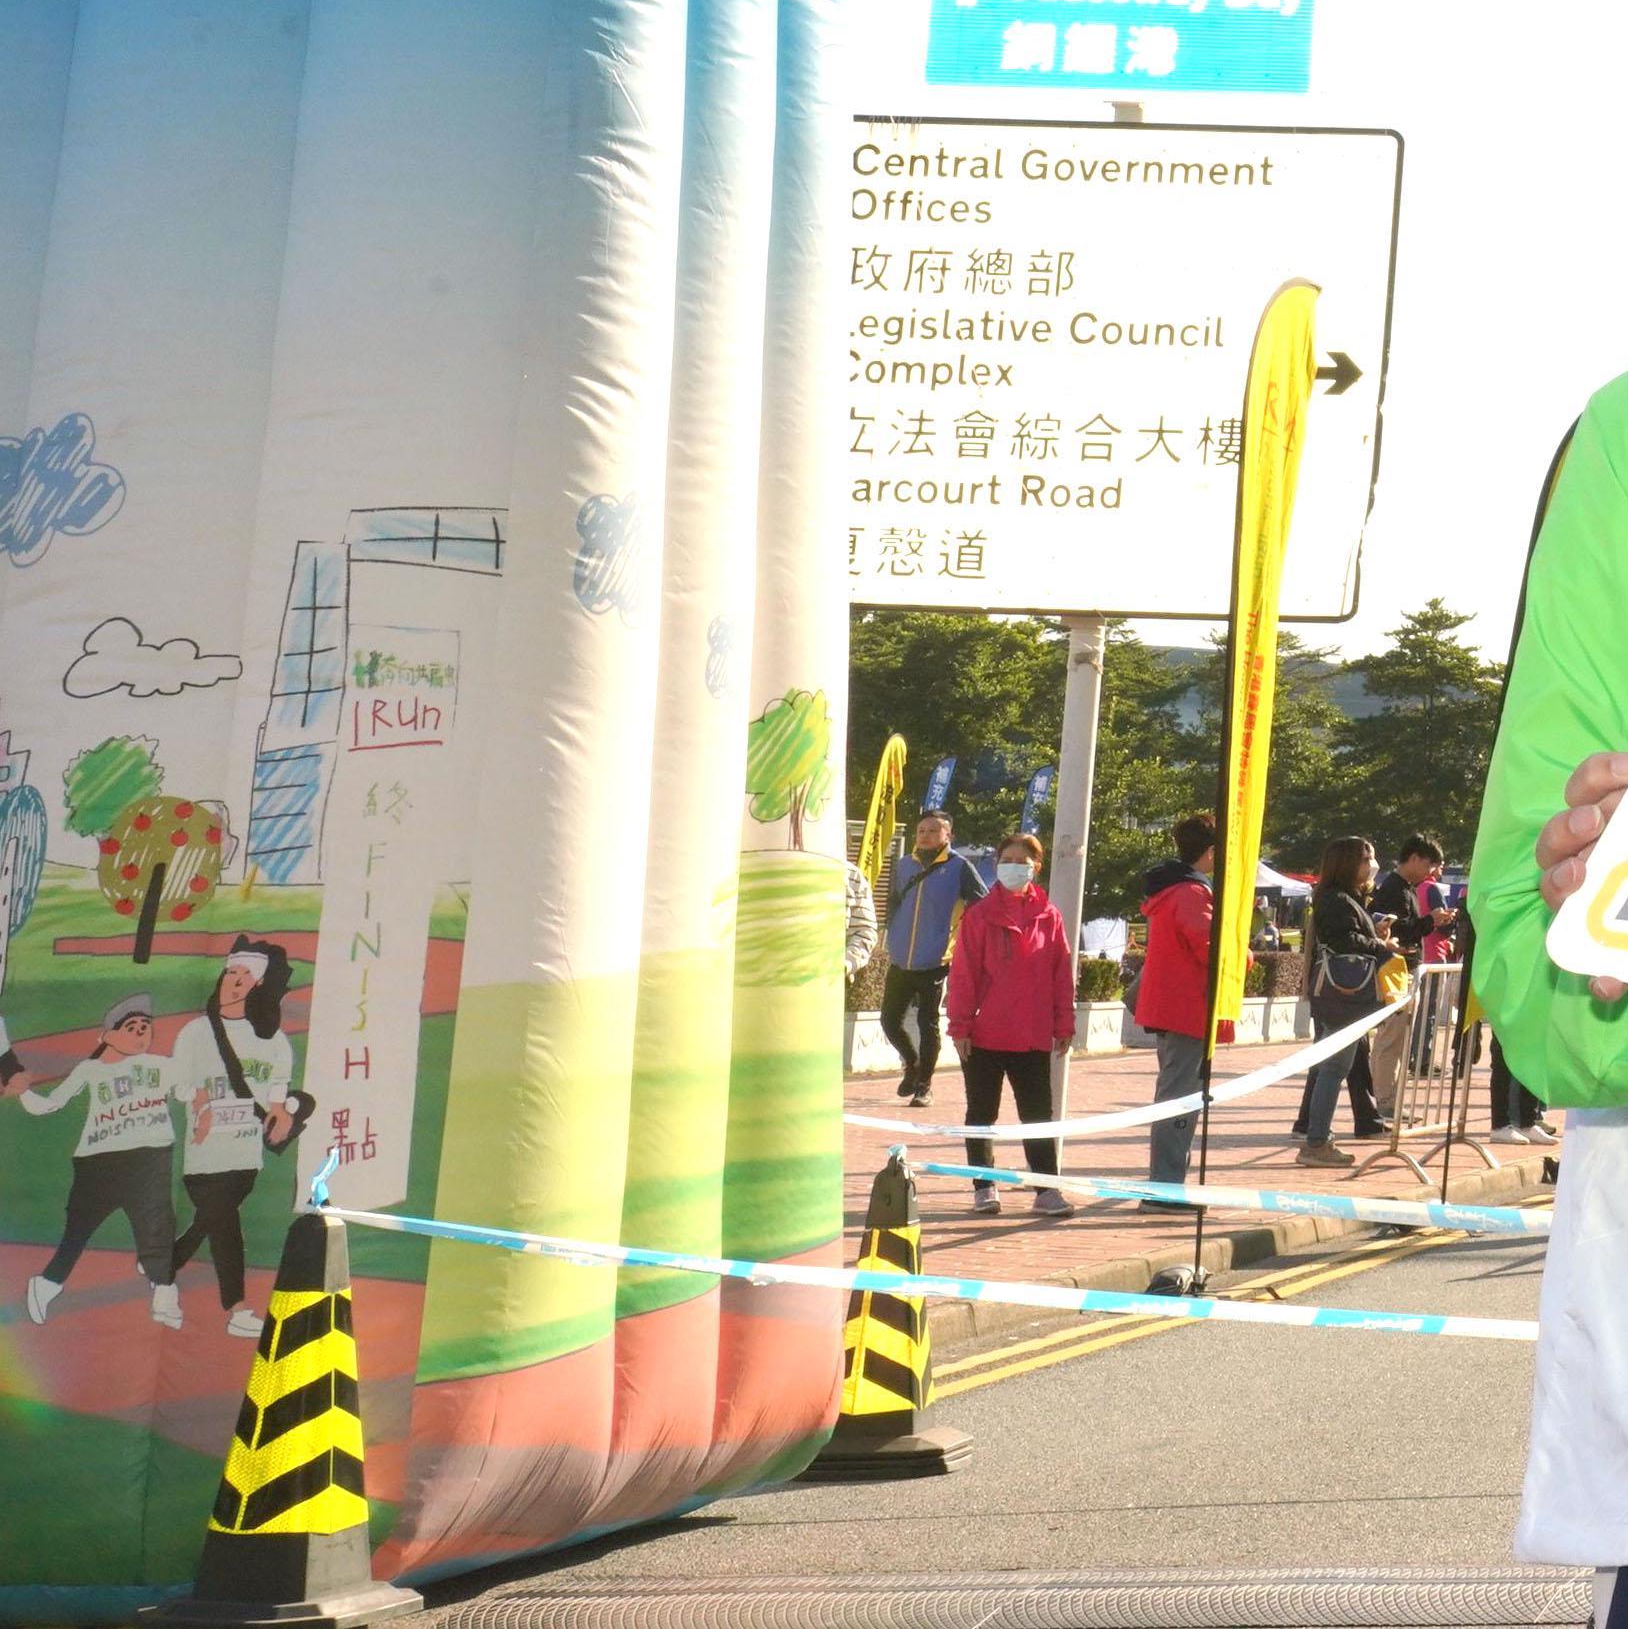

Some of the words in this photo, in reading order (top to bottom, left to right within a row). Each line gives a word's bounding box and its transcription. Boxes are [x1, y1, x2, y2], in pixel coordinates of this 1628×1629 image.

[852, 143, 1002, 181] Central
[1020, 148, 1274, 187] Government
[851, 188, 993, 224] Offices
[850, 243, 1077, 298] 政府總部
[849, 308, 1052, 346] egislative
[1068, 311, 1225, 348] Council
[851, 475, 1002, 505] arcourt
[1020, 475, 1123, 509] Road
